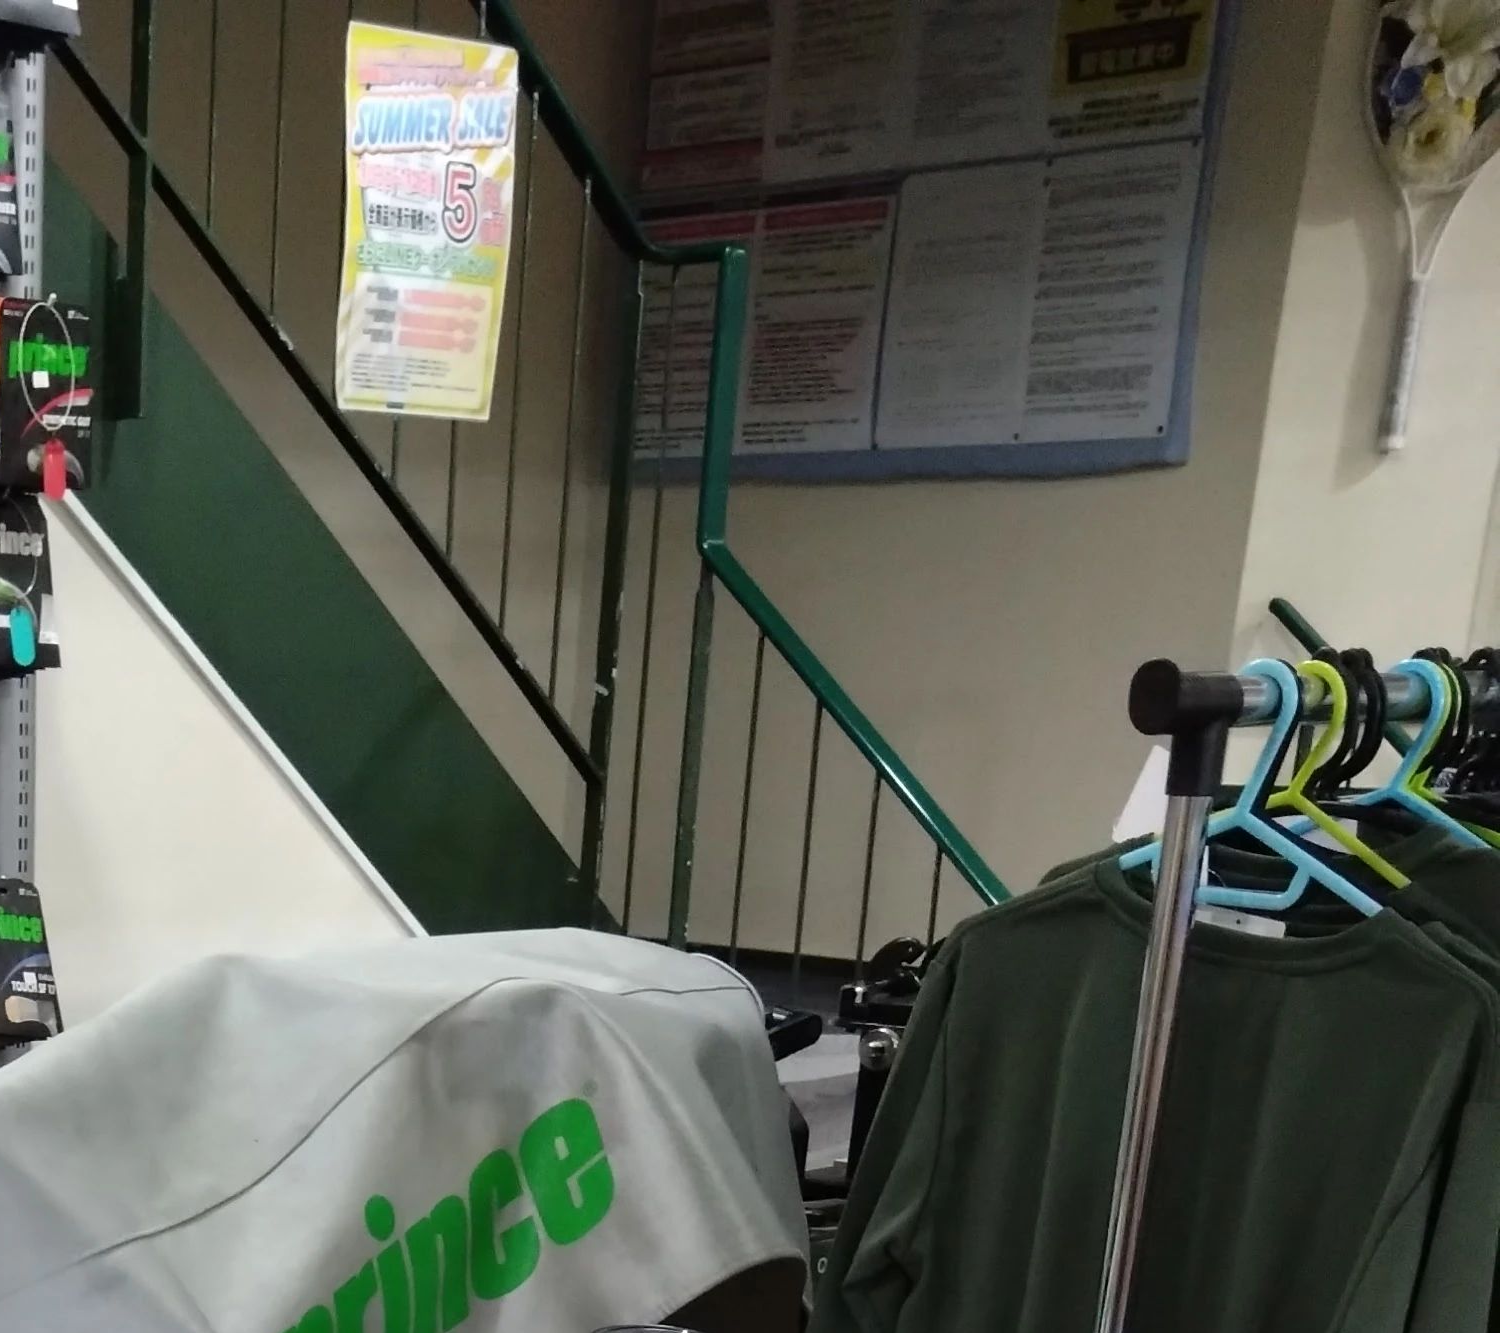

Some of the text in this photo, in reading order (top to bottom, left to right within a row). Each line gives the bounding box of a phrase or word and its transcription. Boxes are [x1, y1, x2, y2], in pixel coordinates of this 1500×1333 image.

[354, 90, 511, 147] SUMMER SALE
[442, 161, 477, 243] 5
